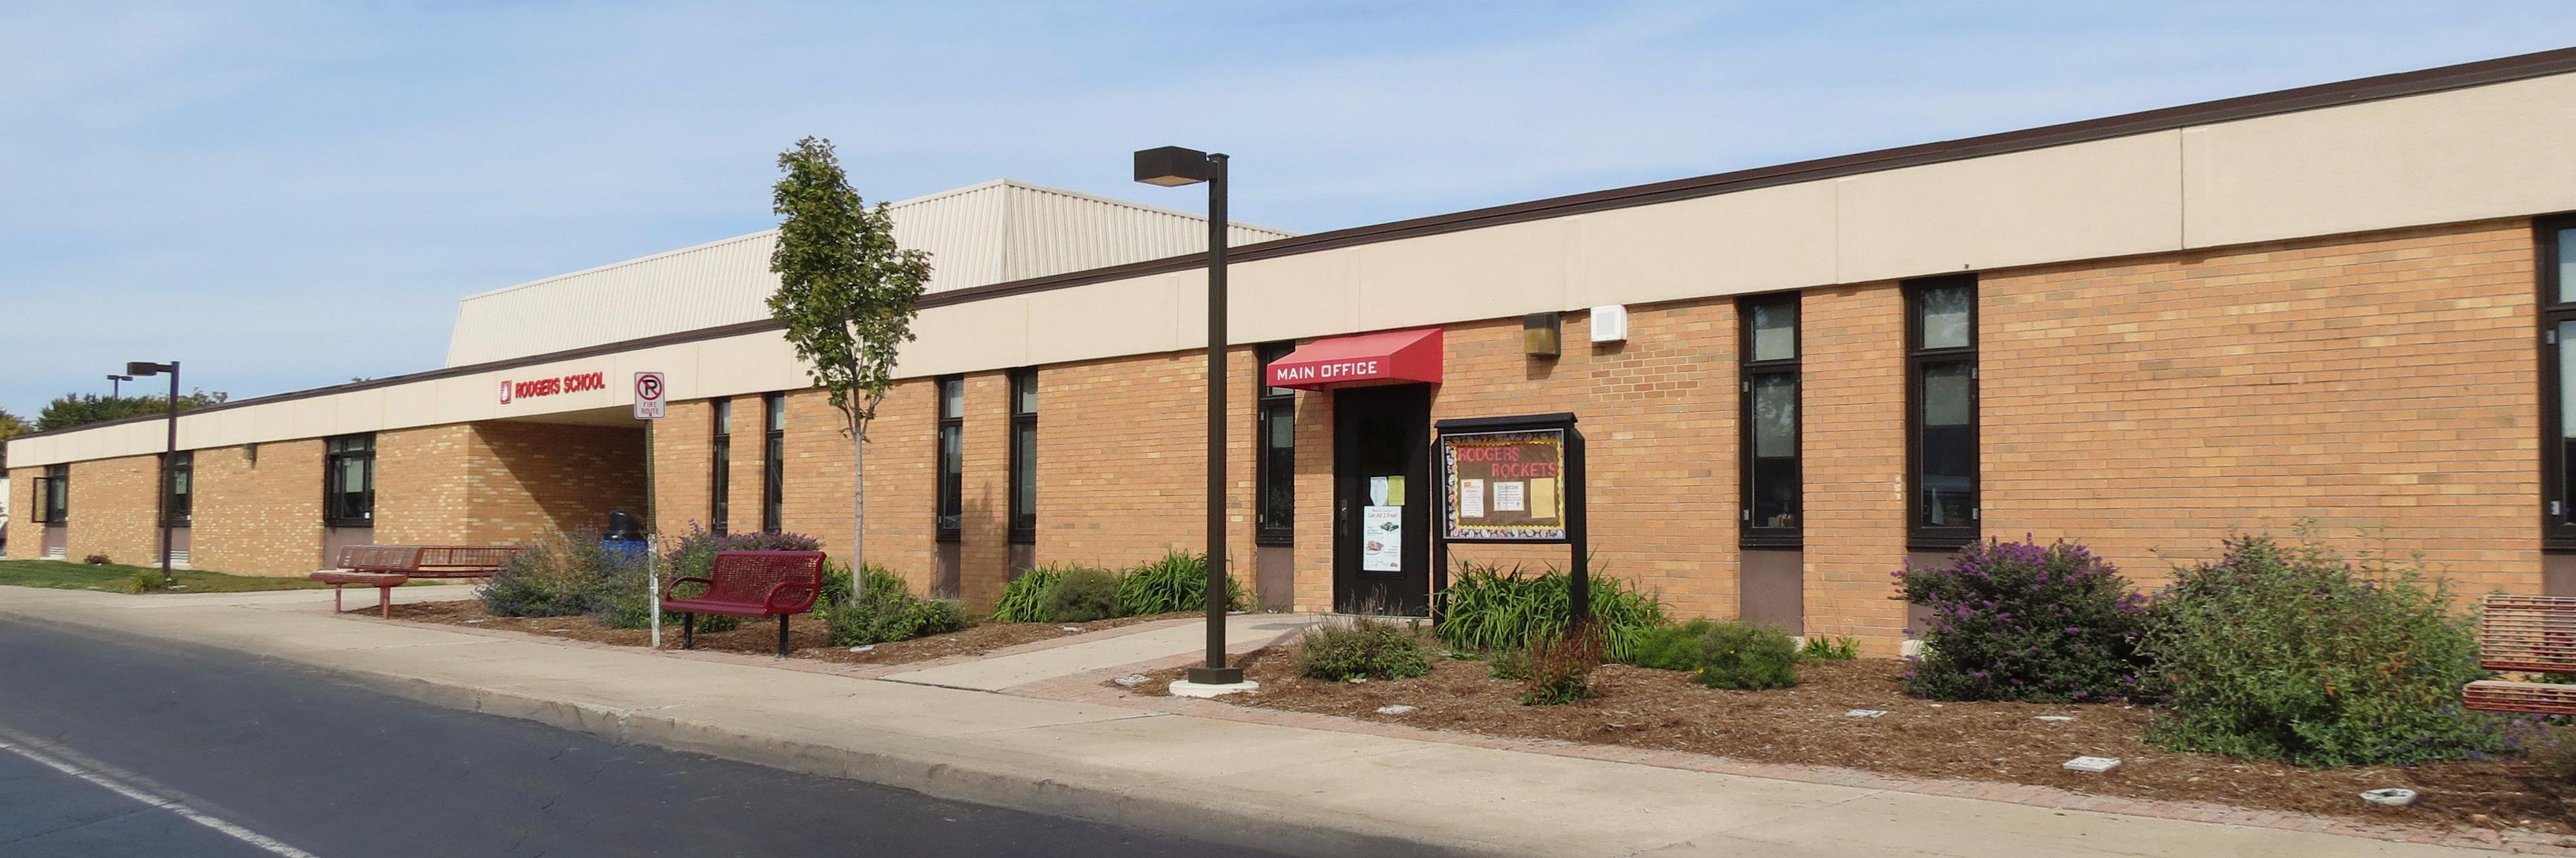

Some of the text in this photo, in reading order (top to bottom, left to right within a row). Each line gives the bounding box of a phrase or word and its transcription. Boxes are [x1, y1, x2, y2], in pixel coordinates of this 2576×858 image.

[1277, 360, 1378, 381] MAIN OFFICE
[515, 371, 606, 399] RODGERS SCHOOL
[645, 380, 658, 396] P
[1457, 447, 1520, 462] RODGERS
[1492, 462, 1557, 478] ROCKETS
